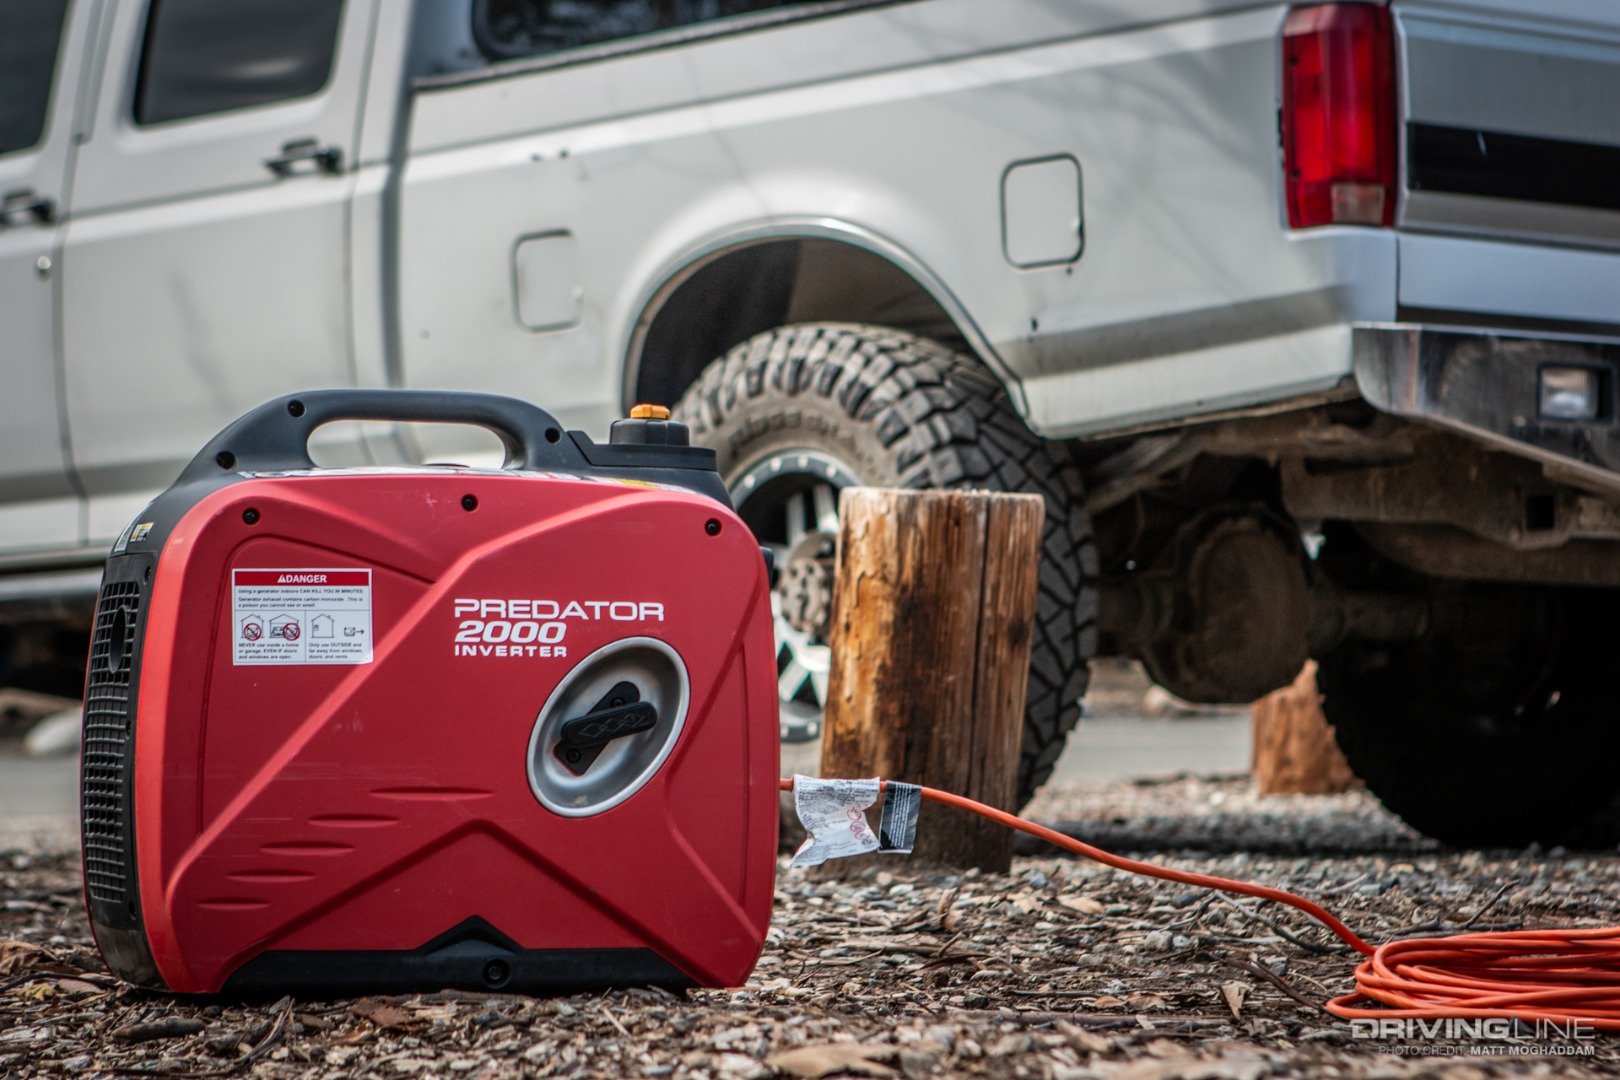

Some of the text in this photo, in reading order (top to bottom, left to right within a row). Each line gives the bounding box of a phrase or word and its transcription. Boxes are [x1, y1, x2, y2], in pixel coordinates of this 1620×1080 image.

[286, 574, 328, 584] DANGER
[454, 598, 664, 621] PREDATOR
[454, 620, 567, 644] 2000
[454, 645, 567, 658] INVERTER
